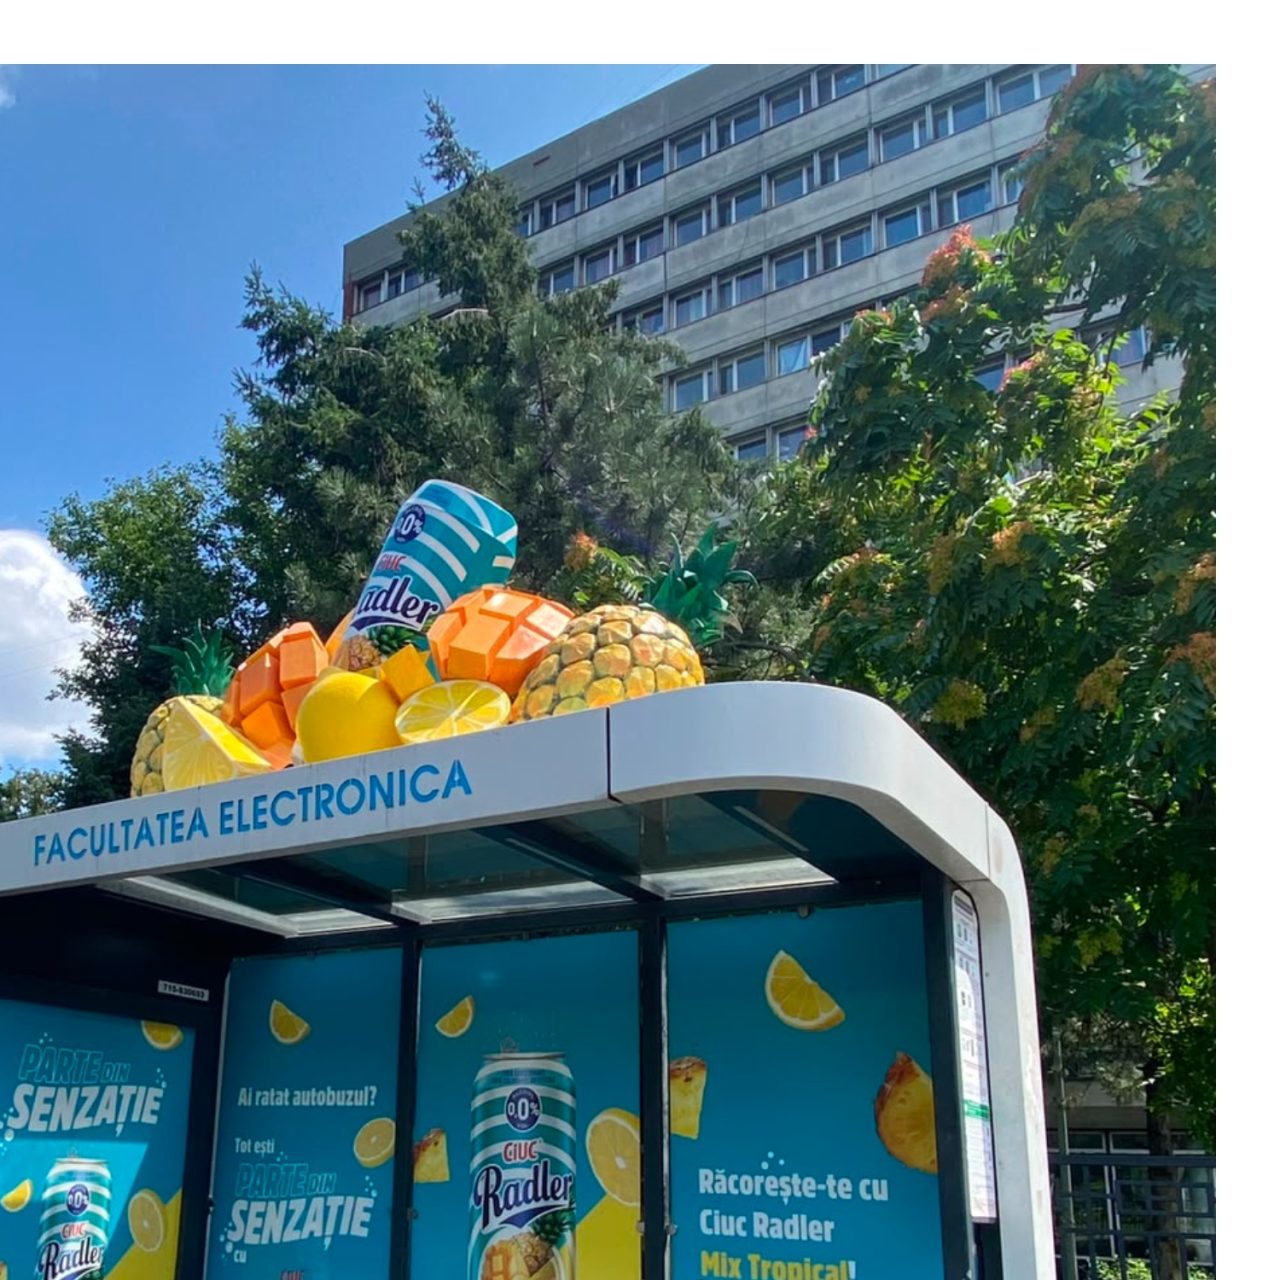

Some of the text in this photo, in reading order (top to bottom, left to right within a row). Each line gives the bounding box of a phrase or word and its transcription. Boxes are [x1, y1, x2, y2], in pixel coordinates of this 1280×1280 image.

[357, 577, 439, 625] adler
[33, 760, 472, 866] FACULTATEA ELECTRONICA
[18, 1044, 131, 1085] PARTE DIN
[7, 1083, 163, 1137] SENZAȚIE
[238, 1085, 377, 1106] Ai ratat autobuzul?
[235, 1137, 275, 1158] Tot ești
[235, 1163, 336, 1198] PARTE DIN
[474, 1160, 573, 1229] Radler
[698, 1168, 889, 1206] Răcorește-te cu
[227, 1196, 375, 1250] SENZAȚIE
[699, 1209, 835, 1242] Ciuc Radler
[234, 1250, 247, 1263] cu
[700, 1250, 742, 1279] Mix
